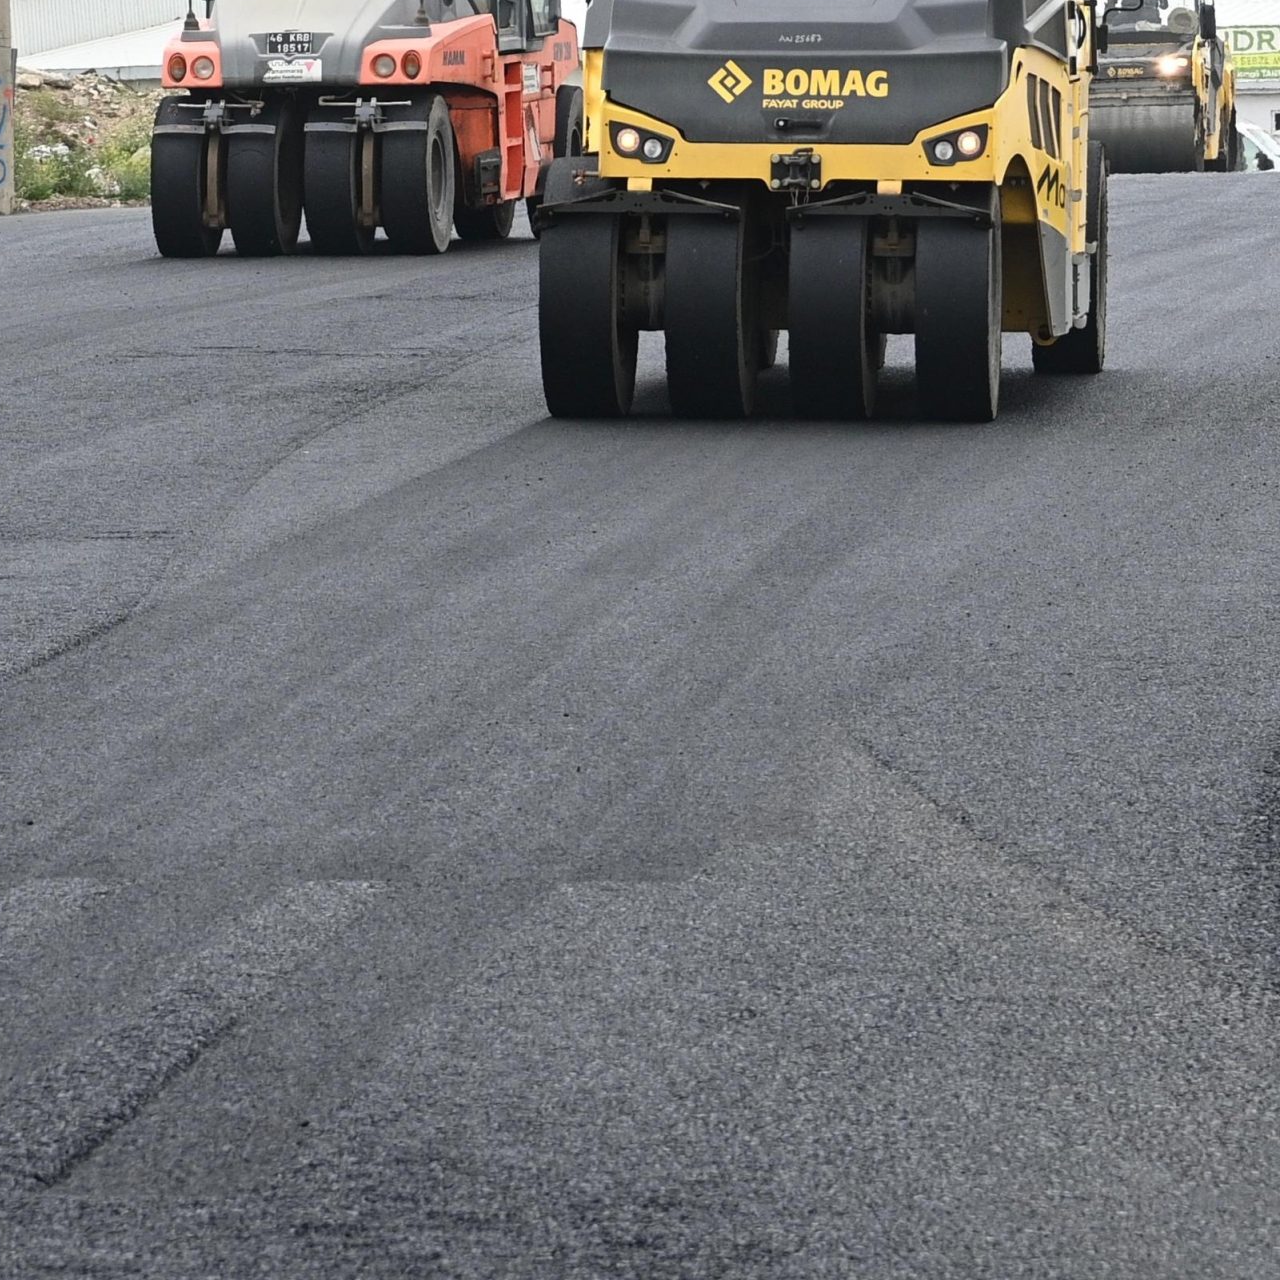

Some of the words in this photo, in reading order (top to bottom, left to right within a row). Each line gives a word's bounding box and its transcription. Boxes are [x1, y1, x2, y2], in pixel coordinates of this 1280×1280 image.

[269, 33, 283, 43] 46
[289, 33, 310, 43] KRB
[276, 43, 310, 53] 18517
[762, 68, 889, 98] BOMAG
[762, 99, 799, 109] FAYAT
[802, 99, 845, 110] GROUP
